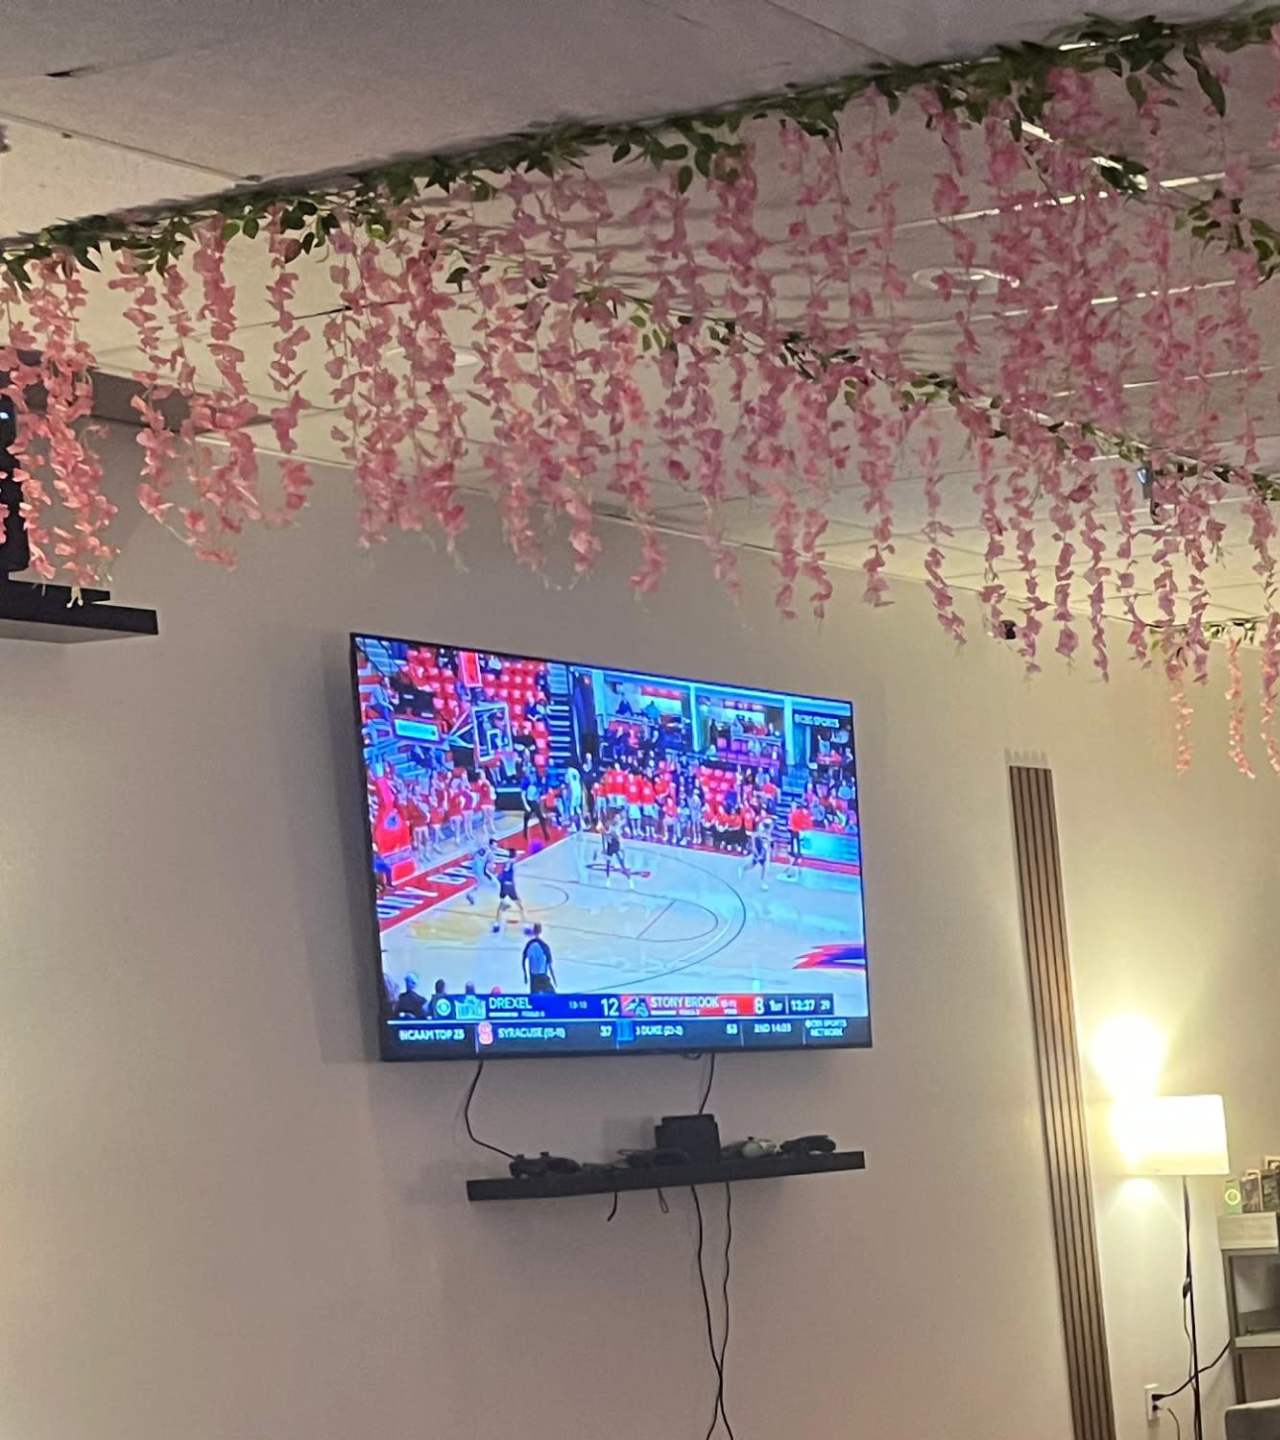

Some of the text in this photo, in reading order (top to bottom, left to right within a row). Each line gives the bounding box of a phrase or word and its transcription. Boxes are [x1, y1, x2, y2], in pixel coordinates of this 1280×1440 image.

[488, 996, 533, 1009] DREXEL
[600, 997, 620, 1017] 12
[650, 995, 683, 1009] STONY
[684, 995, 719, 1008] BROOK
[754, 996, 765, 1015] 8
[435, 1029, 452, 1040] TOP
